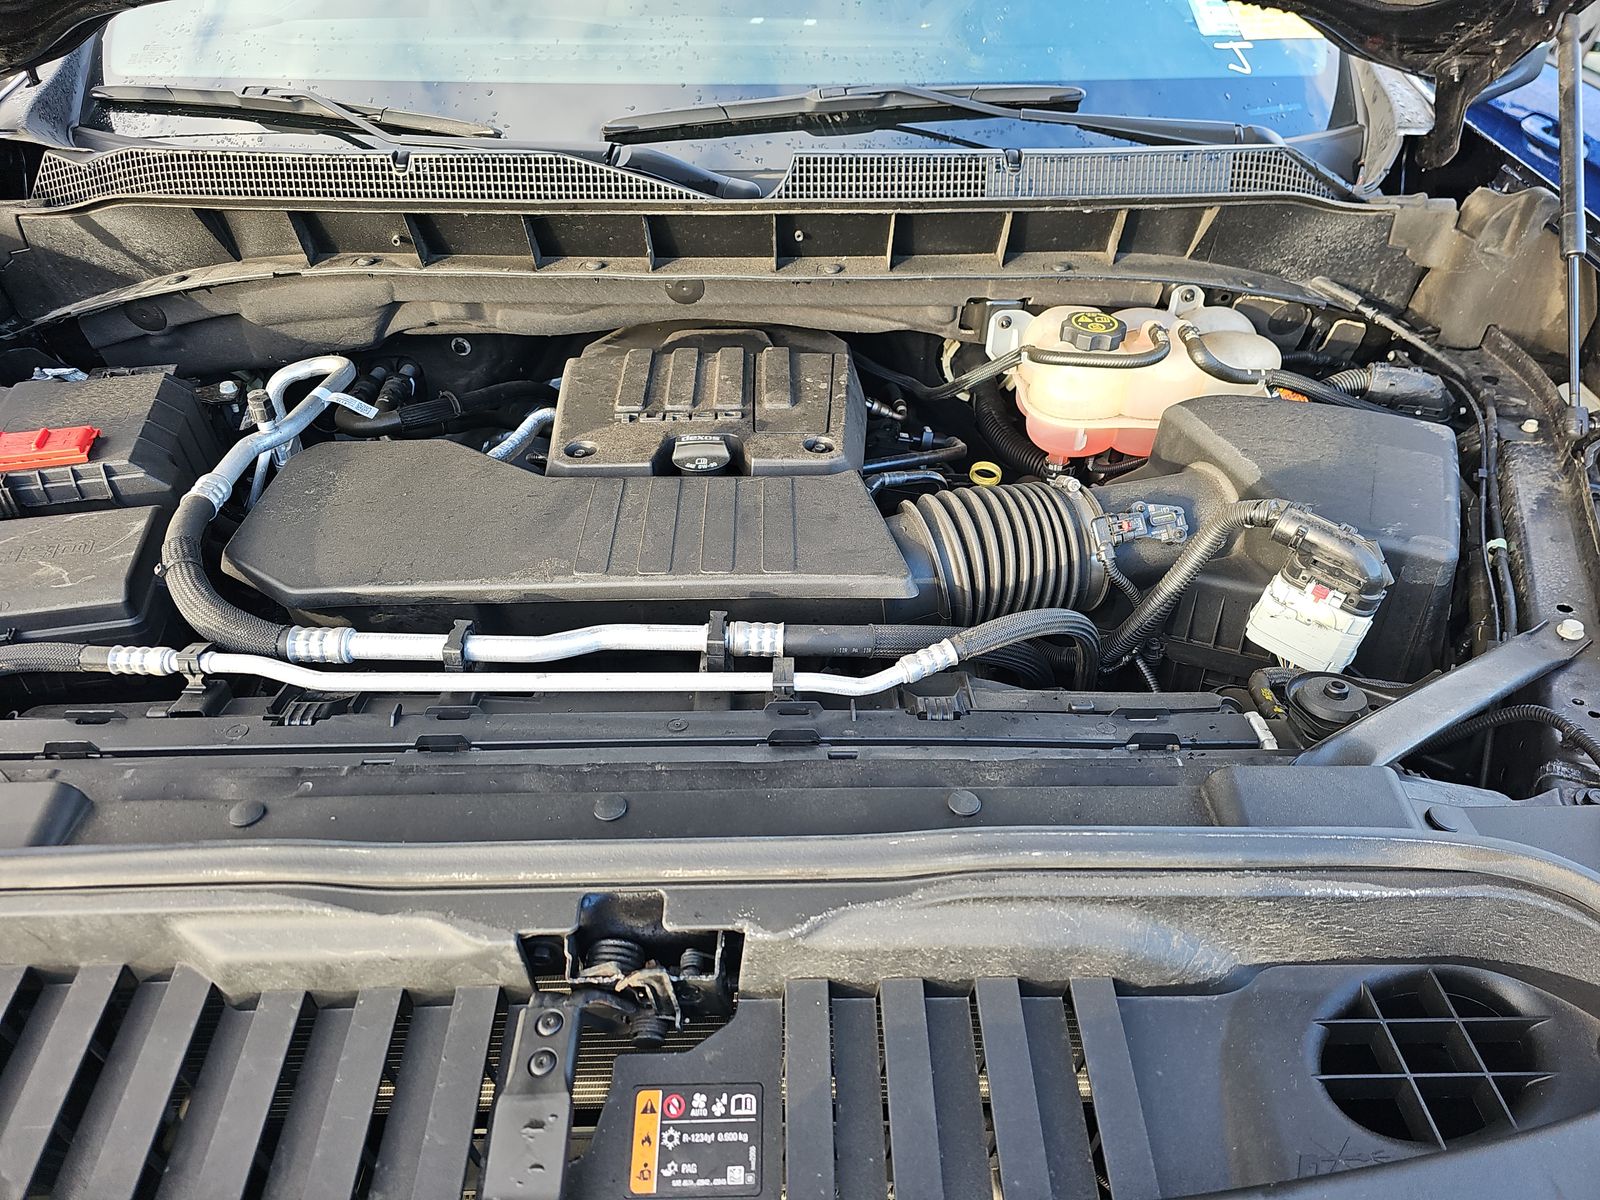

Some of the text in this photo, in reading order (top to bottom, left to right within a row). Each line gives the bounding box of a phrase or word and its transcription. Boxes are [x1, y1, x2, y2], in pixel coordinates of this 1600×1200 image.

[690, 1109, 708, 1117] AUTO
[682, 1133, 715, 1144] R-1234yf
[738, 1131, 748, 1143] kg
[681, 1163, 698, 1174] PAG
